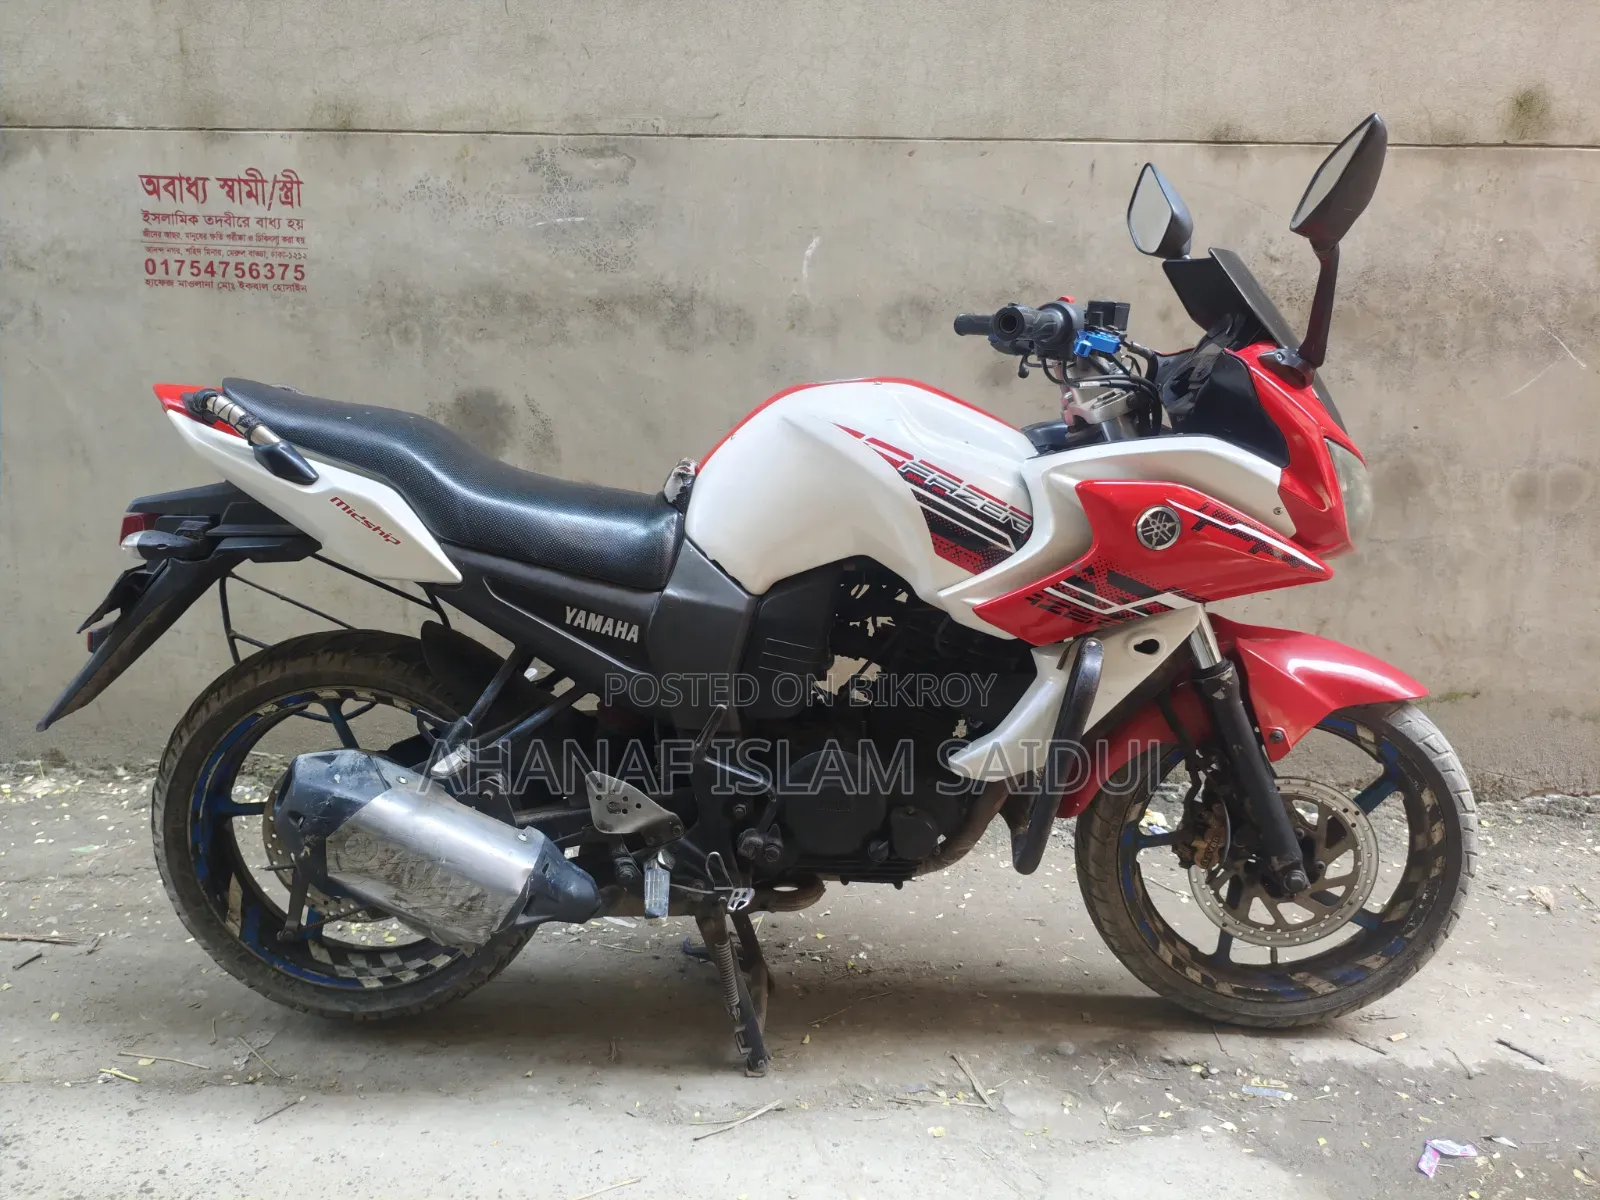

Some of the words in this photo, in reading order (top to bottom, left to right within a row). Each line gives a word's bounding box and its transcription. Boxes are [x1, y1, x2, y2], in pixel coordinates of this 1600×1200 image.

[138, 173, 211, 204] অবাধ্য
[216, 167, 304, 211] স্বামী/স্ত্রী
[141, 208, 199, 227] ইসলামিক
[204, 212, 250, 228] তদবীরে
[255, 216, 282, 230] বাধ্য
[286, 219, 305, 231] হয়
[145, 258, 306, 281] 01754756375
[896, 459, 1032, 534] FAZER
[565, 605, 640, 644] YAMAHA
